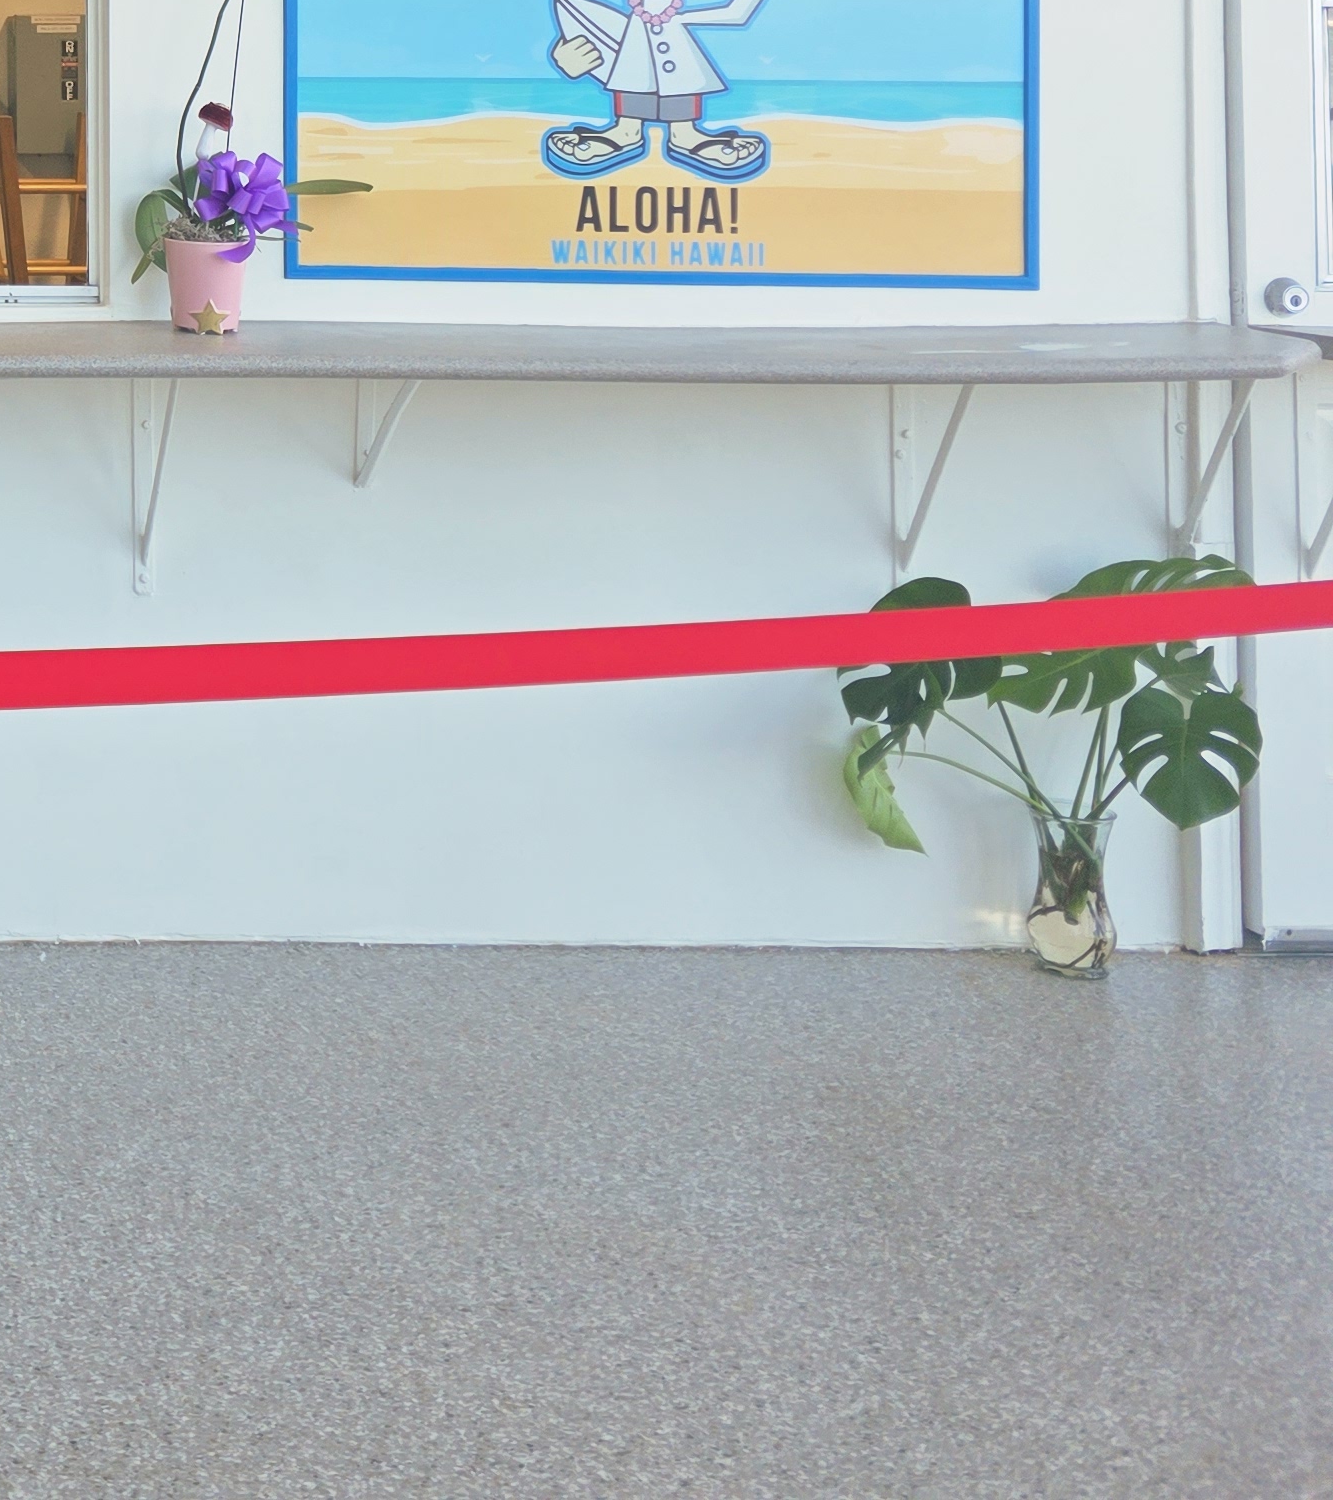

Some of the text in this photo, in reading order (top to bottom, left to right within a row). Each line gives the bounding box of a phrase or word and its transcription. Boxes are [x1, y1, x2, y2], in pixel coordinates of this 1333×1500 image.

[576, 185, 740, 235] ALOHA!
[551, 239, 765, 266] WAIKIKI HAWAII
